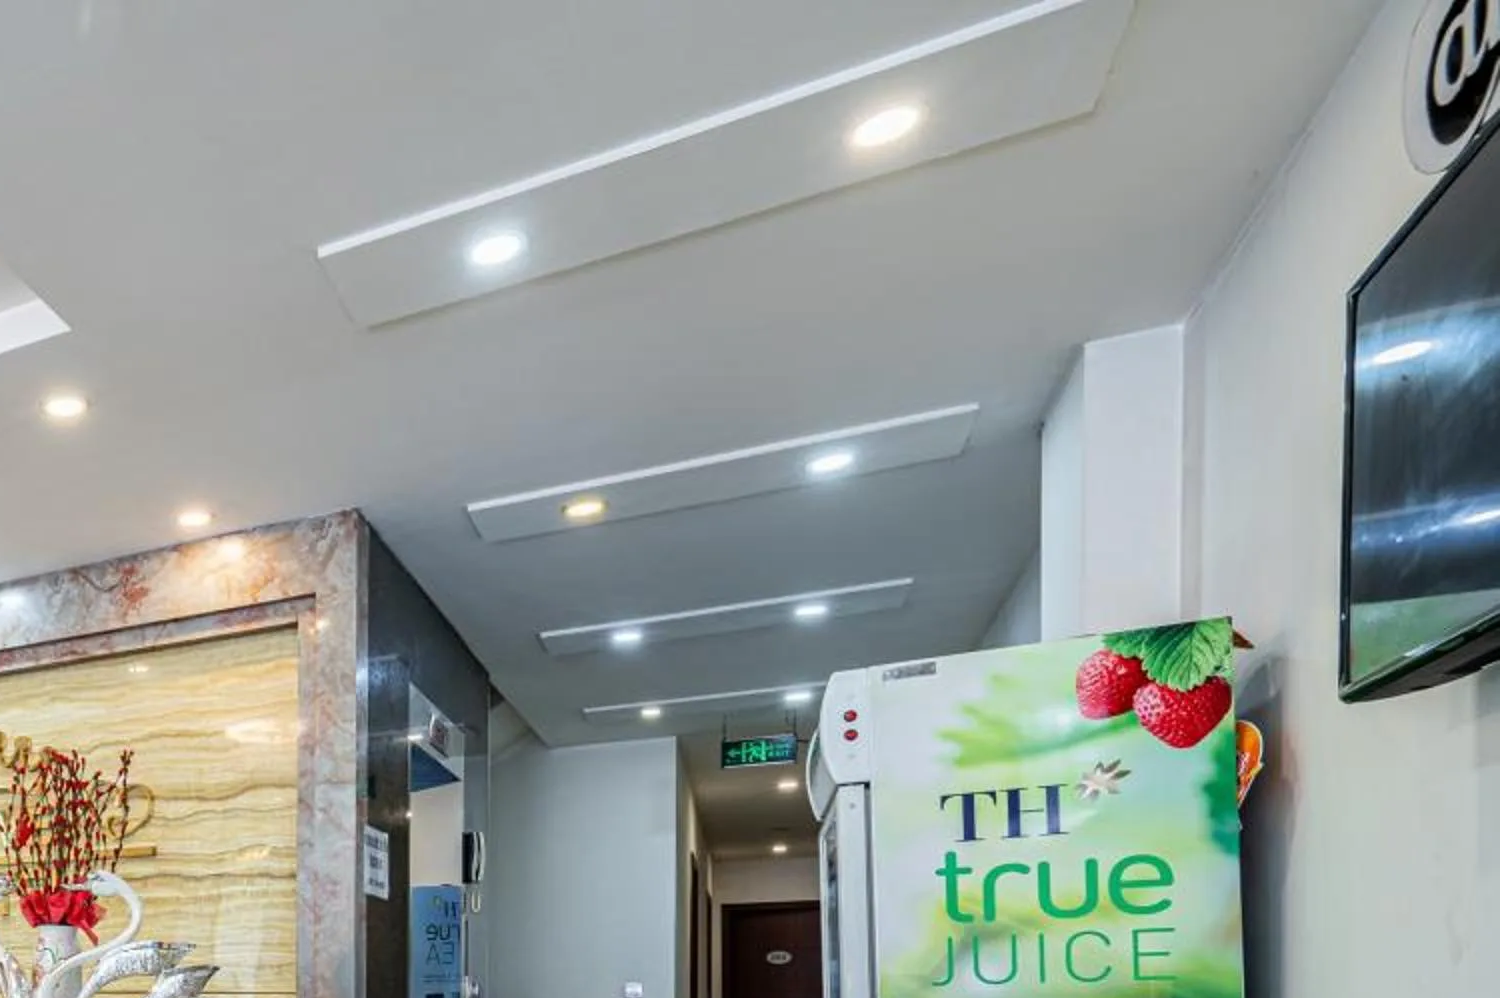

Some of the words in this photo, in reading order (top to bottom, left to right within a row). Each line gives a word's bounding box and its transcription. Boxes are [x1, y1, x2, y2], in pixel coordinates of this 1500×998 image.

[940, 783, 1070, 842] TH
[935, 851, 1175, 924] true
[932, 927, 1177, 987] JUICE
